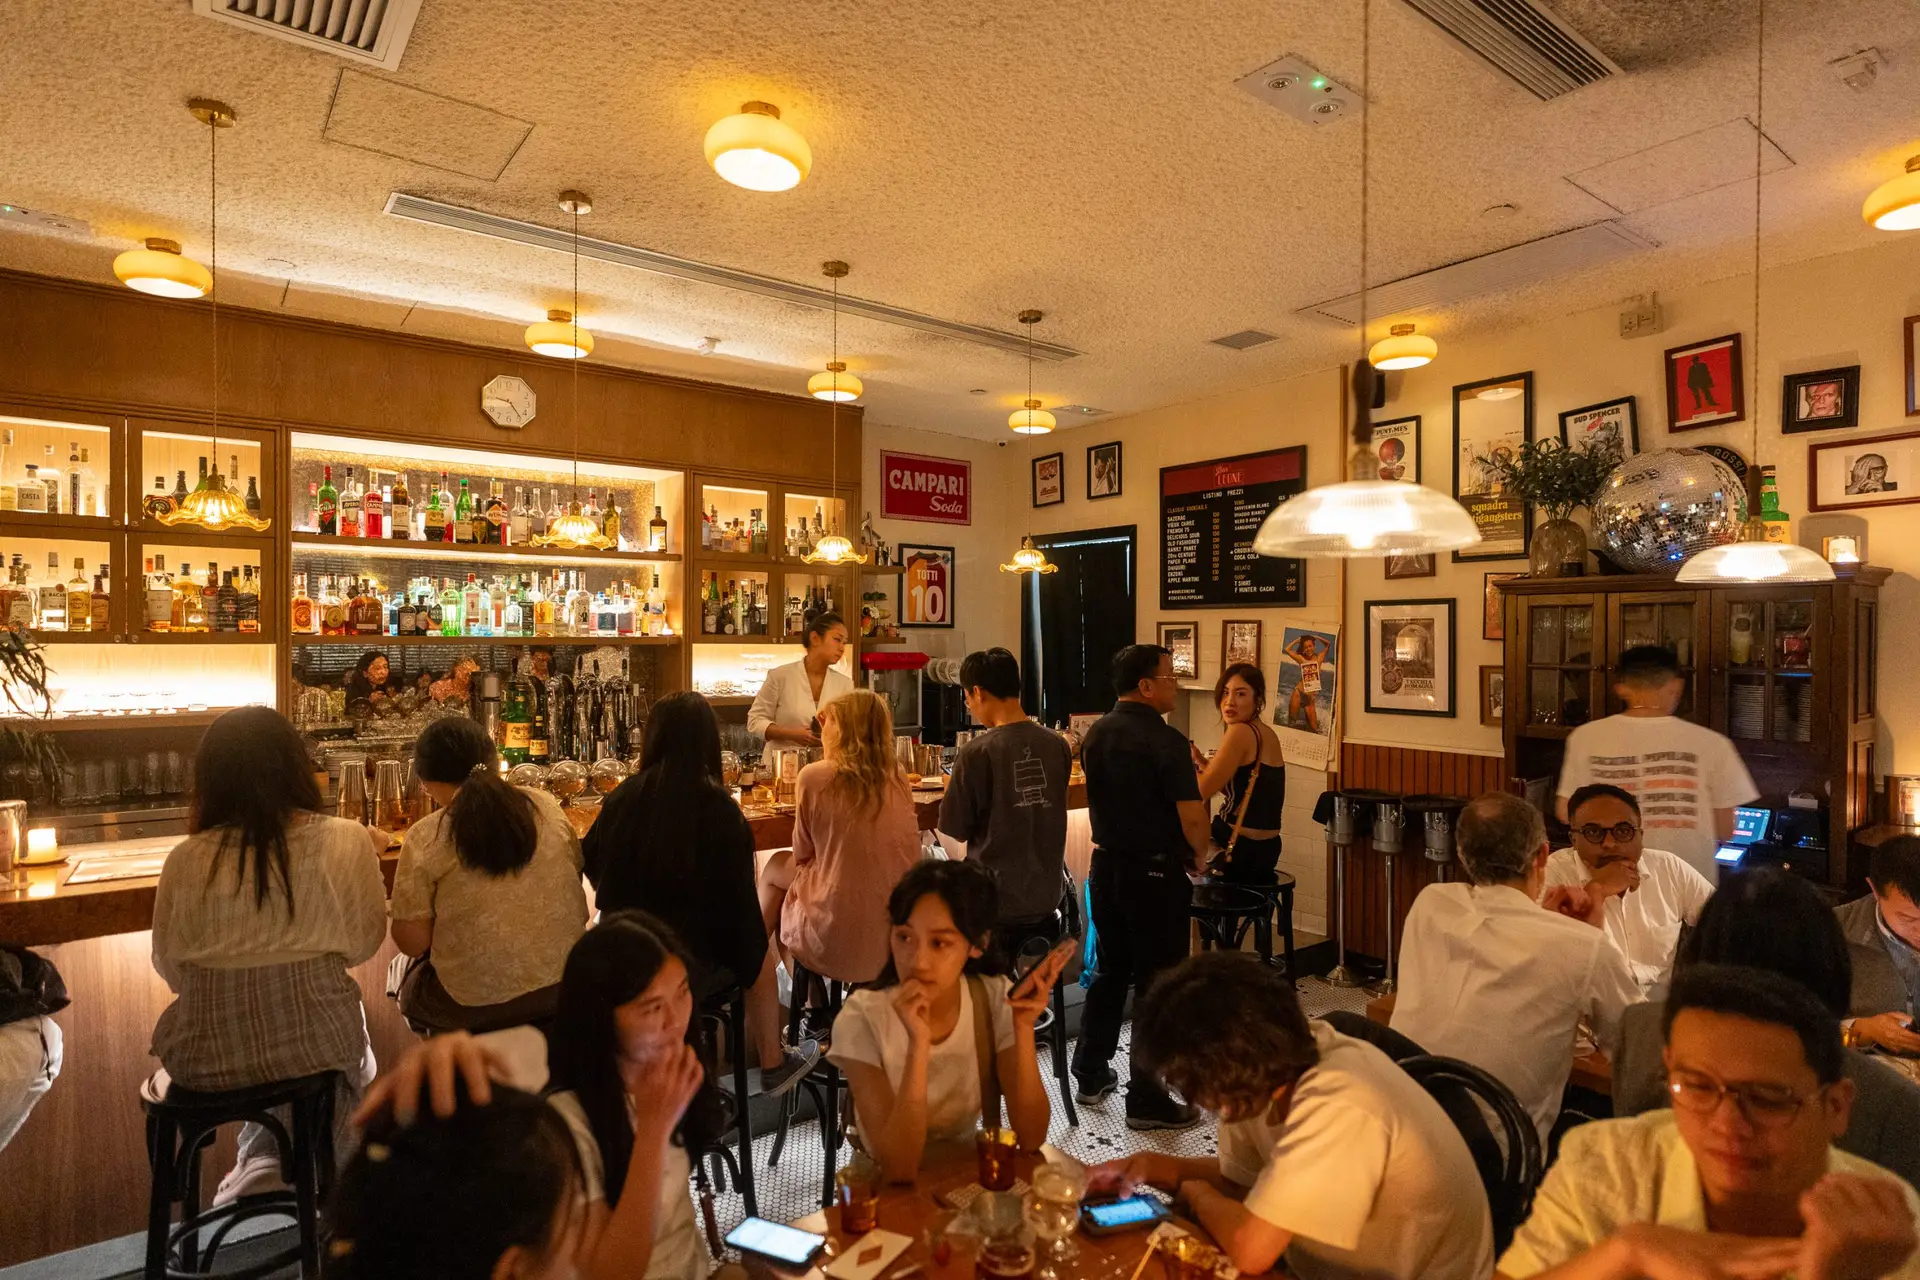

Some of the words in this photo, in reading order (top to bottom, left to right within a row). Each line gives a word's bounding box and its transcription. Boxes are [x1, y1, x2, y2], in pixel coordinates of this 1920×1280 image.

[1574, 415, 1588, 424] BUD
[1589, 408, 1620, 420] SPENCER
[1713, 448, 1746, 472] ROSSI
[889, 468, 964, 496] CAMPARI
[1202, 491, 1223, 499] LISTINO
[929, 496, 964, 514] Soda
[1471, 500, 1508, 514] squadra
[916, 569, 938, 581] TOTTI
[911, 585, 944, 623] 10
